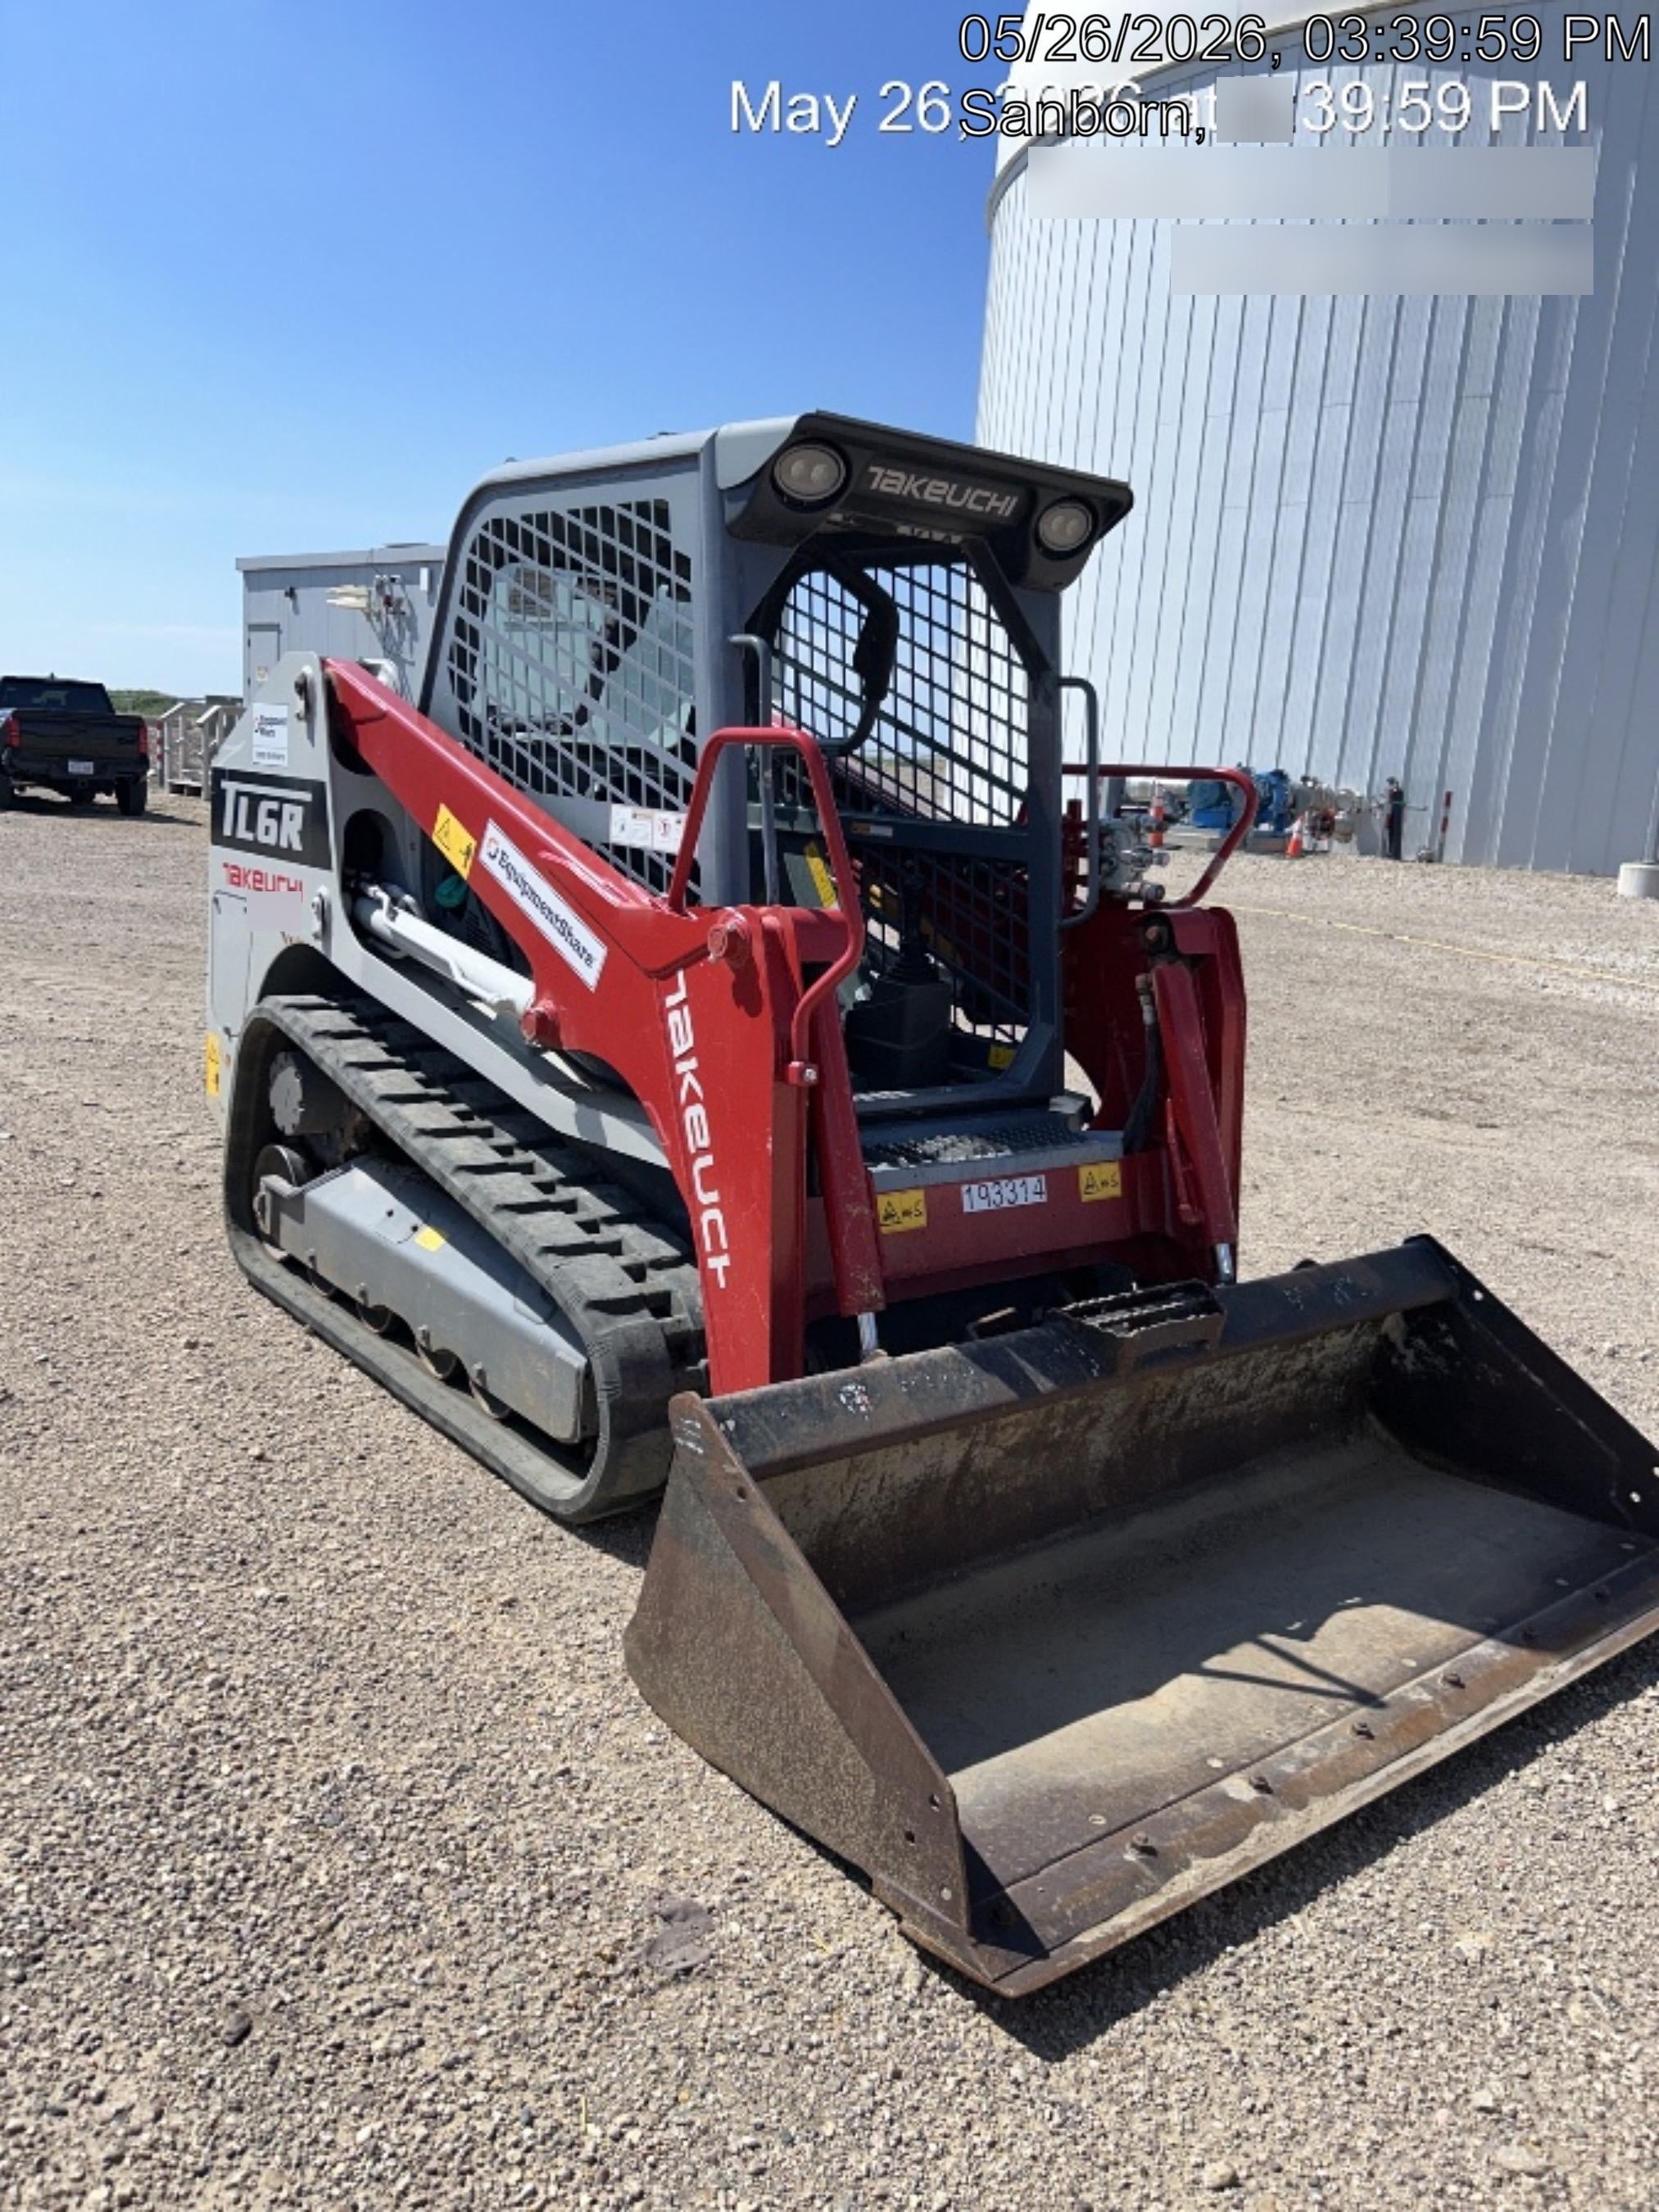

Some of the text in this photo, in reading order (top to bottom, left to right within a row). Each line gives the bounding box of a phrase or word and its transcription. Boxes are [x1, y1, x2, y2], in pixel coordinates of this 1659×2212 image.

[868, 465, 1018, 517] TAKEUCHI
[220, 780, 312, 851] TL6R
[965, 1178, 1045, 1209] 193314
